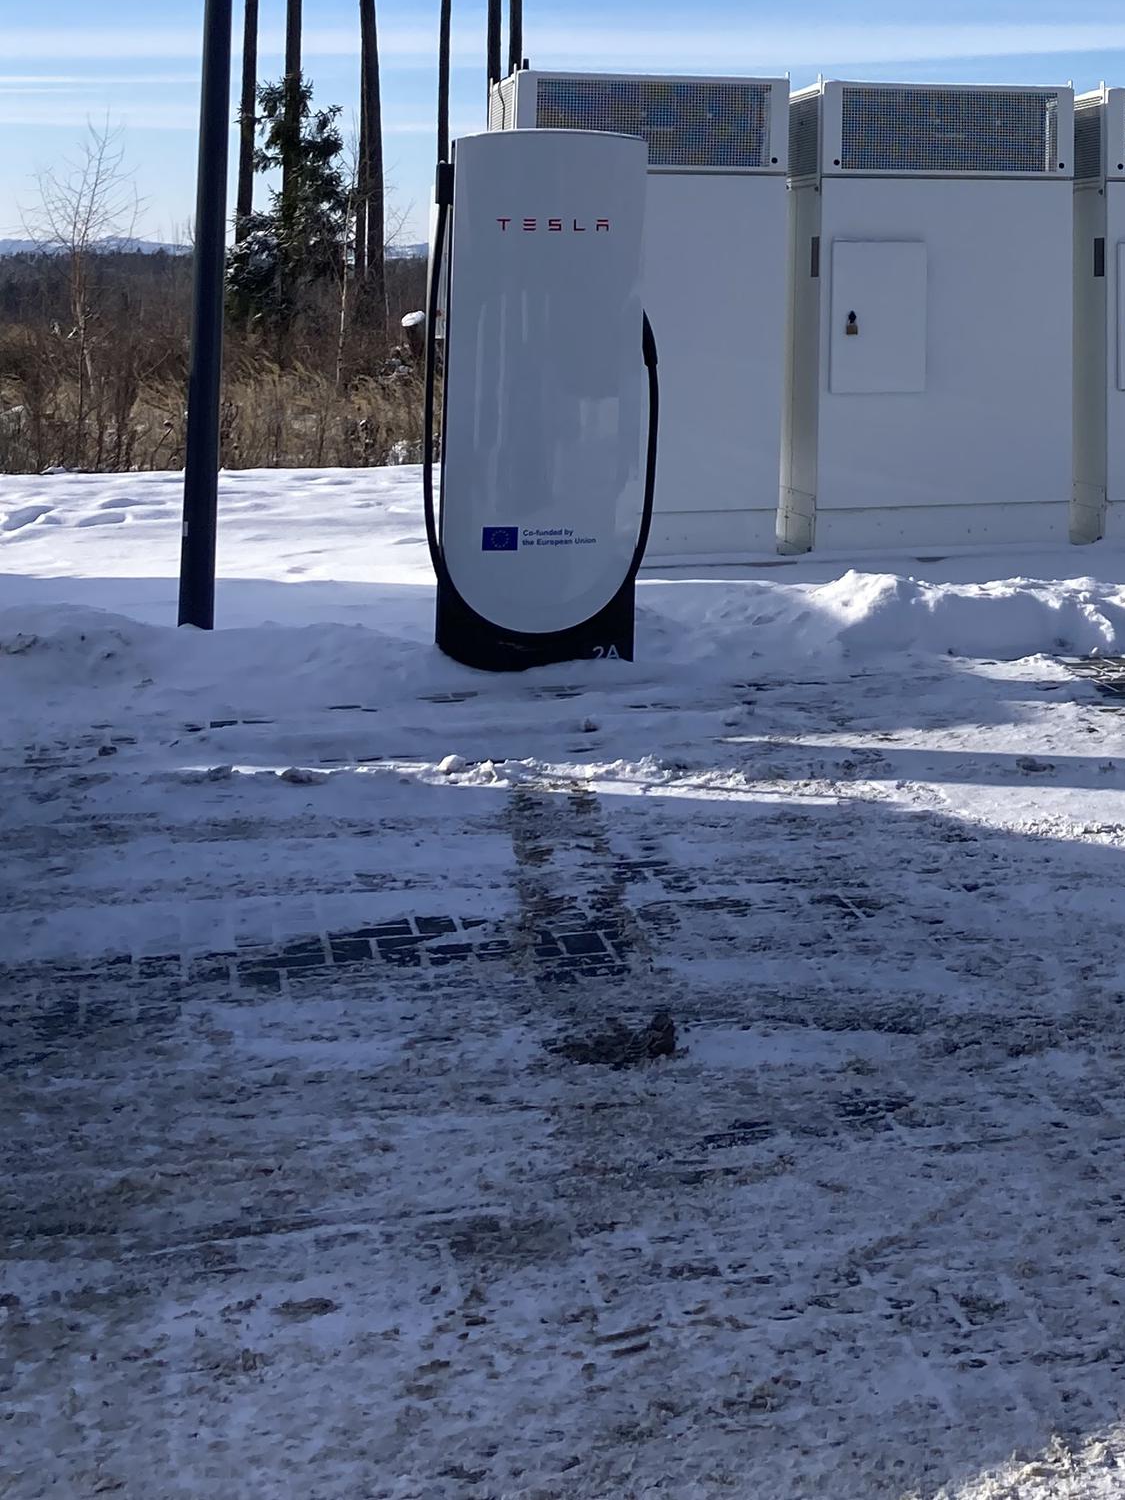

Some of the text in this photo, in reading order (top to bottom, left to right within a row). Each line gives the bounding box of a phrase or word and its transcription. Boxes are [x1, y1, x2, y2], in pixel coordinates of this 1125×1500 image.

[496, 219, 609, 231] TESLA
[522, 529, 574, 537] Co-funded by
[536, 538, 573, 547] European
[592, 644, 620, 660] 2A
